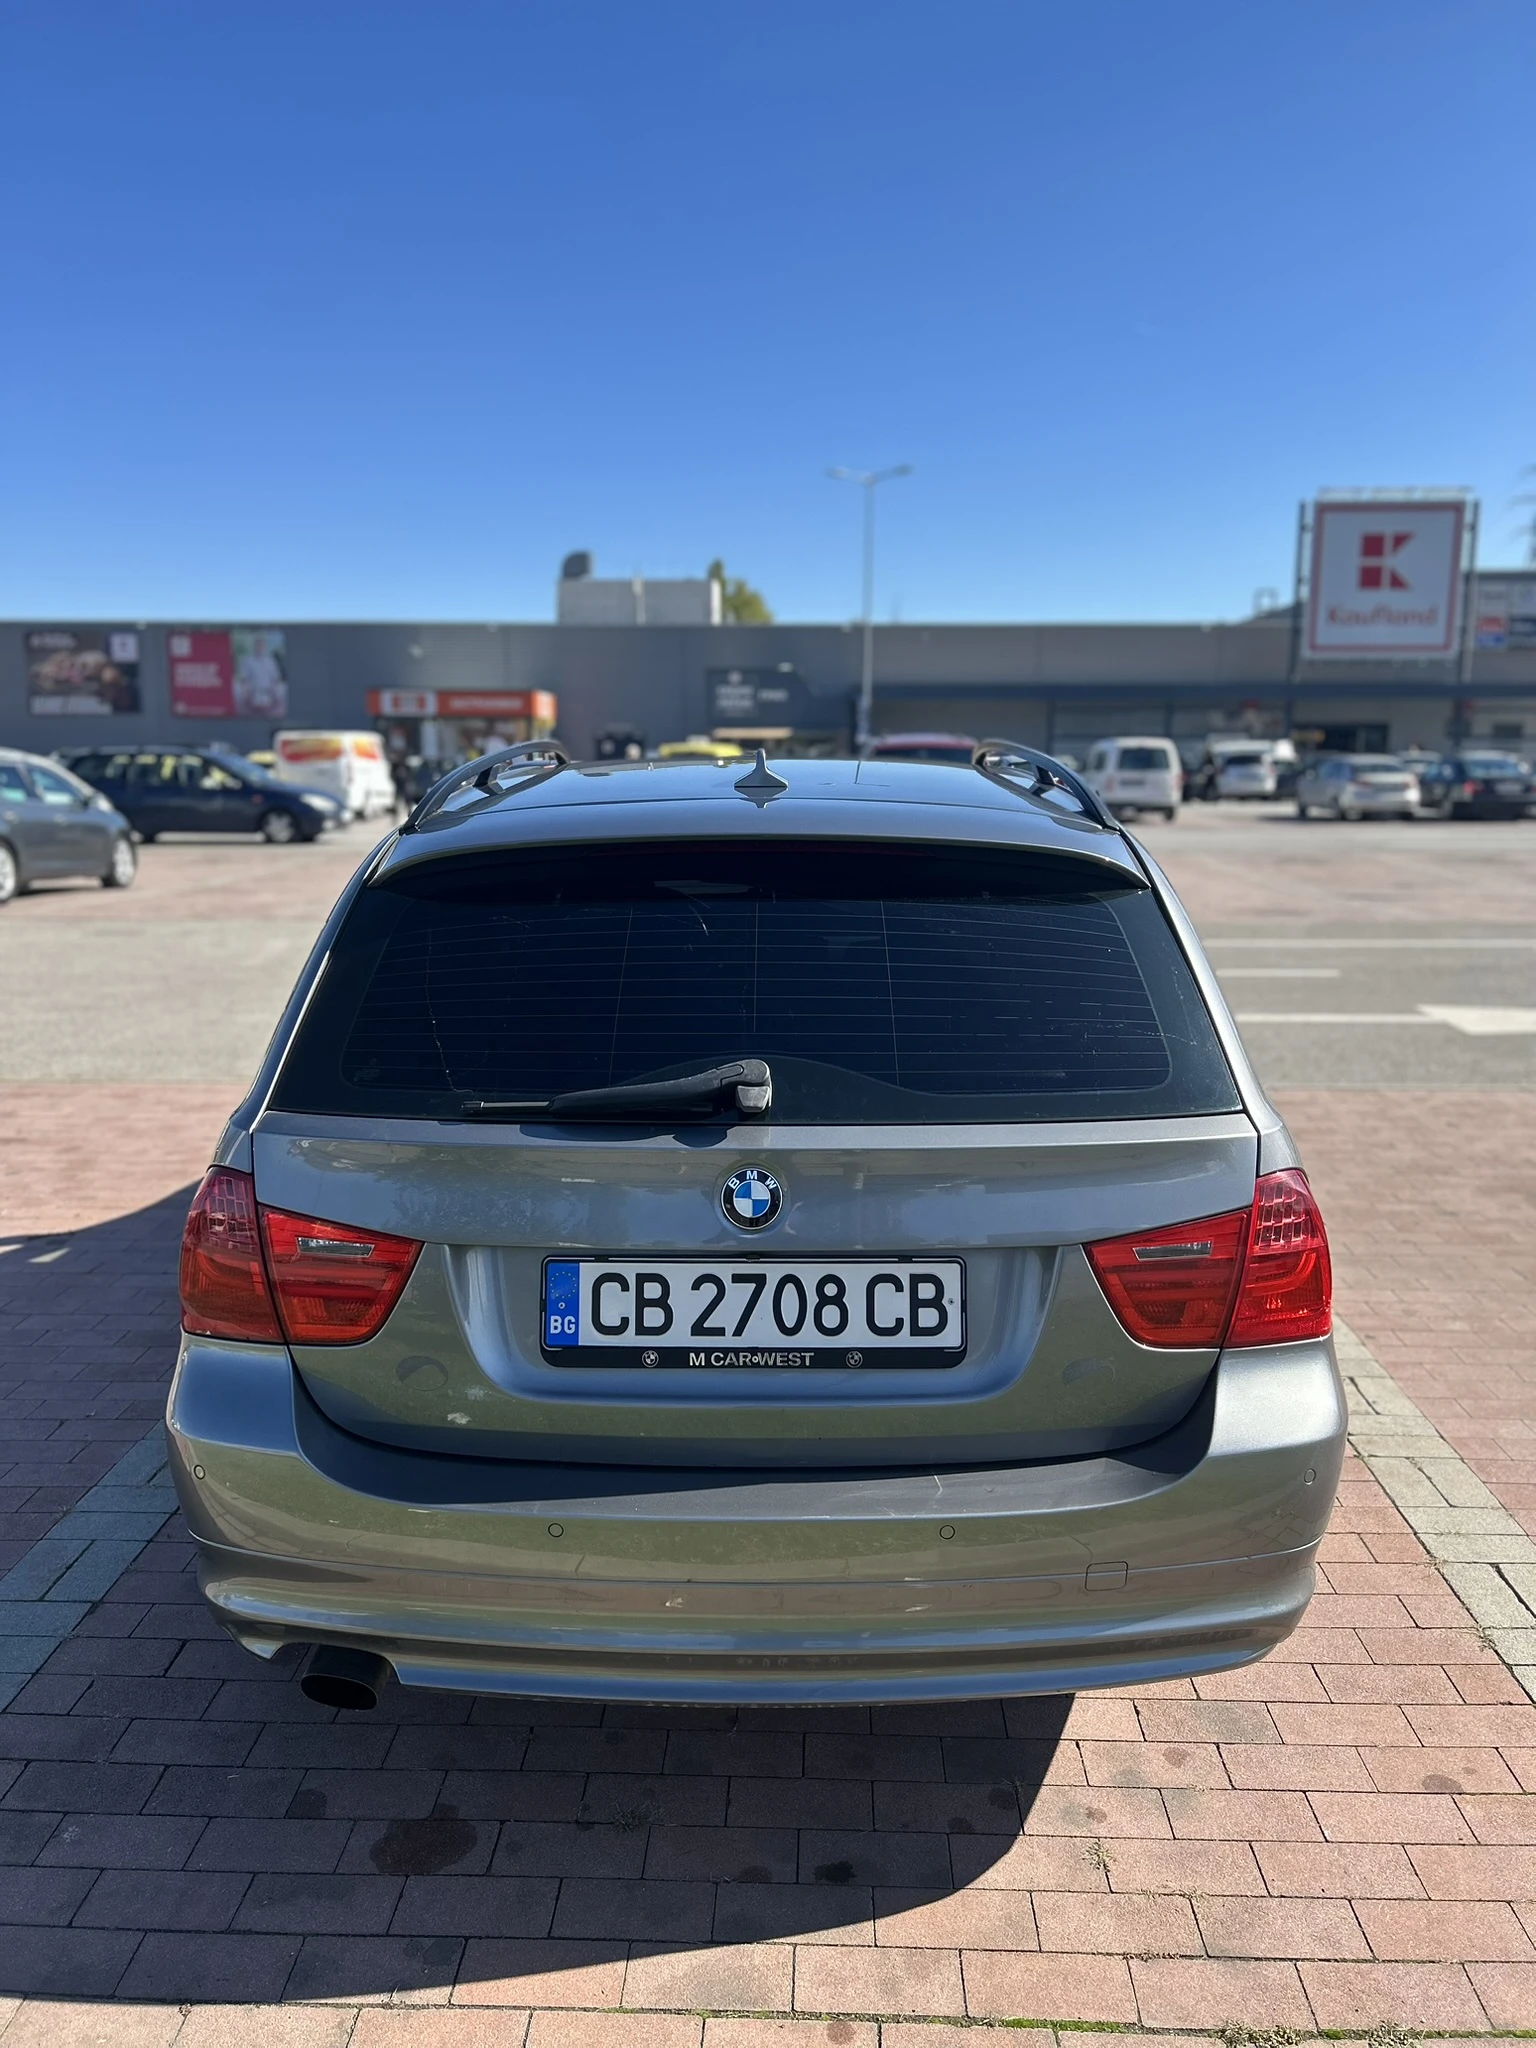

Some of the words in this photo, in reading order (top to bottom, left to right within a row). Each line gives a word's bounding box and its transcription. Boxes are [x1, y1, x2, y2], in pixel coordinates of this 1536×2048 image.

[728, 1170, 777, 1190] BMW
[591, 1273, 673, 1336] CB
[690, 1273, 849, 1337] 2708
[866, 1273, 949, 1336] CB
[550, 1315, 576, 1334] BG
[689, 1352, 705, 1366] M
[710, 1352, 752, 1366] CAR
[758, 1352, 815, 1366] WEST
